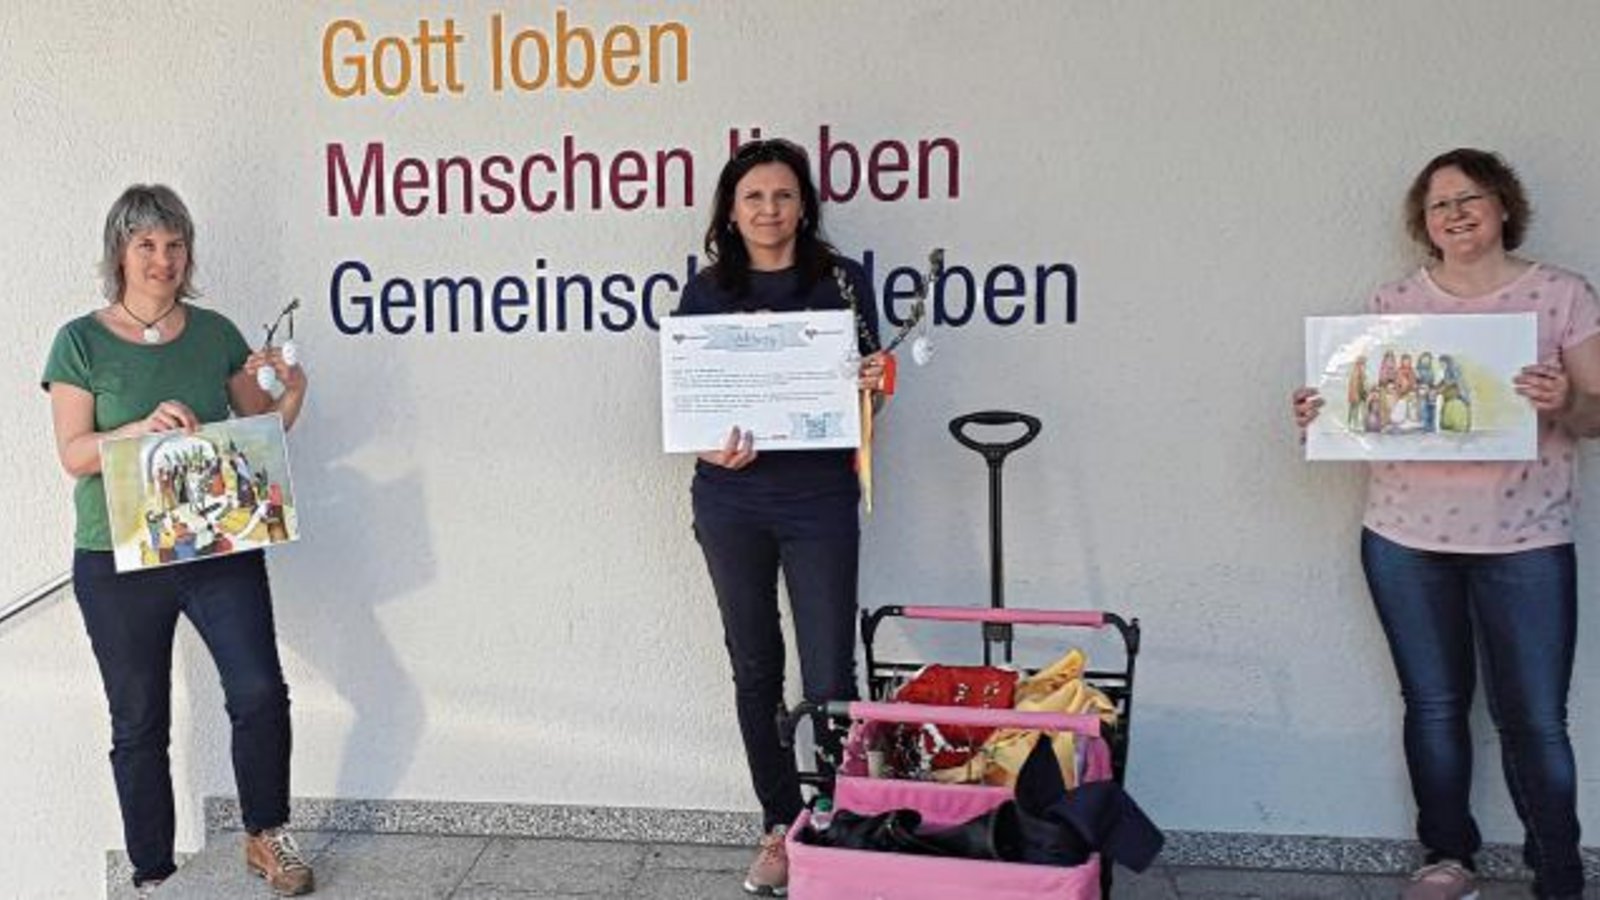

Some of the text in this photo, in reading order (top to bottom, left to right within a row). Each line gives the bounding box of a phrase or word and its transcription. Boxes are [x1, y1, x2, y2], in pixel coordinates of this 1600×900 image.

[322, 10, 689, 97] Gott loben
[326, 125, 961, 217] Menschen ben
